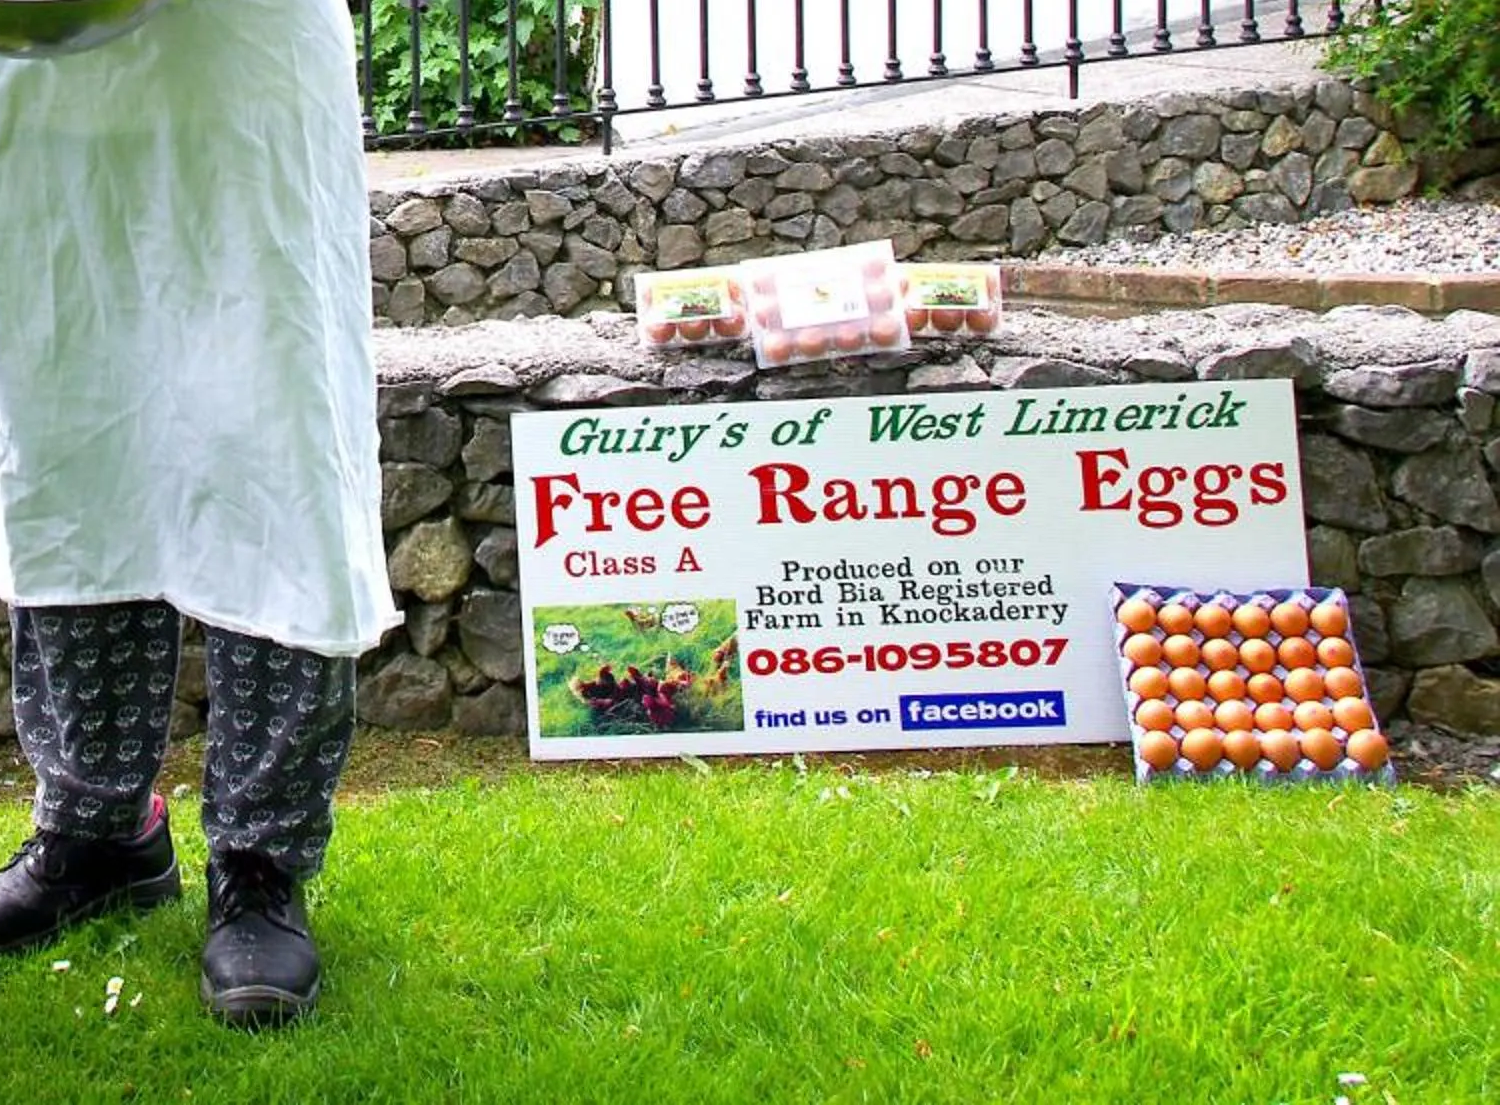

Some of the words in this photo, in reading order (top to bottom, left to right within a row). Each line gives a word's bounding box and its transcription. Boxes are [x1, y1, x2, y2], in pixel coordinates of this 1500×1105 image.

[560, 413, 748, 462] Guiry's
[771, 408, 832, 446] of
[868, 402, 986, 441] West
[1004, 391, 1247, 437] Limerick
[530, 472, 711, 549] Free
[747, 462, 1027, 536] Range
[1076, 448, 1288, 529] Eggs
[564, 551, 657, 577] Class
[676, 547, 703, 572] A
[782, 557, 911, 582] Produced
[927, 559, 960, 577] on
[976, 557, 1024, 574] our
[756, 584, 823, 606] Bord
[838, 582, 884, 603] Bia
[900, 575, 1053, 603] Registered
[744, 609, 822, 630] Farm
[836, 605, 864, 626] in
[880, 600, 1069, 626] Knockaderry
[747, 639, 1069, 676] 086-1095807
[755, 709, 806, 728] find
[814, 710, 847, 725] us
[856, 708, 891, 724] on
[908, 698, 1058, 722] facebook
